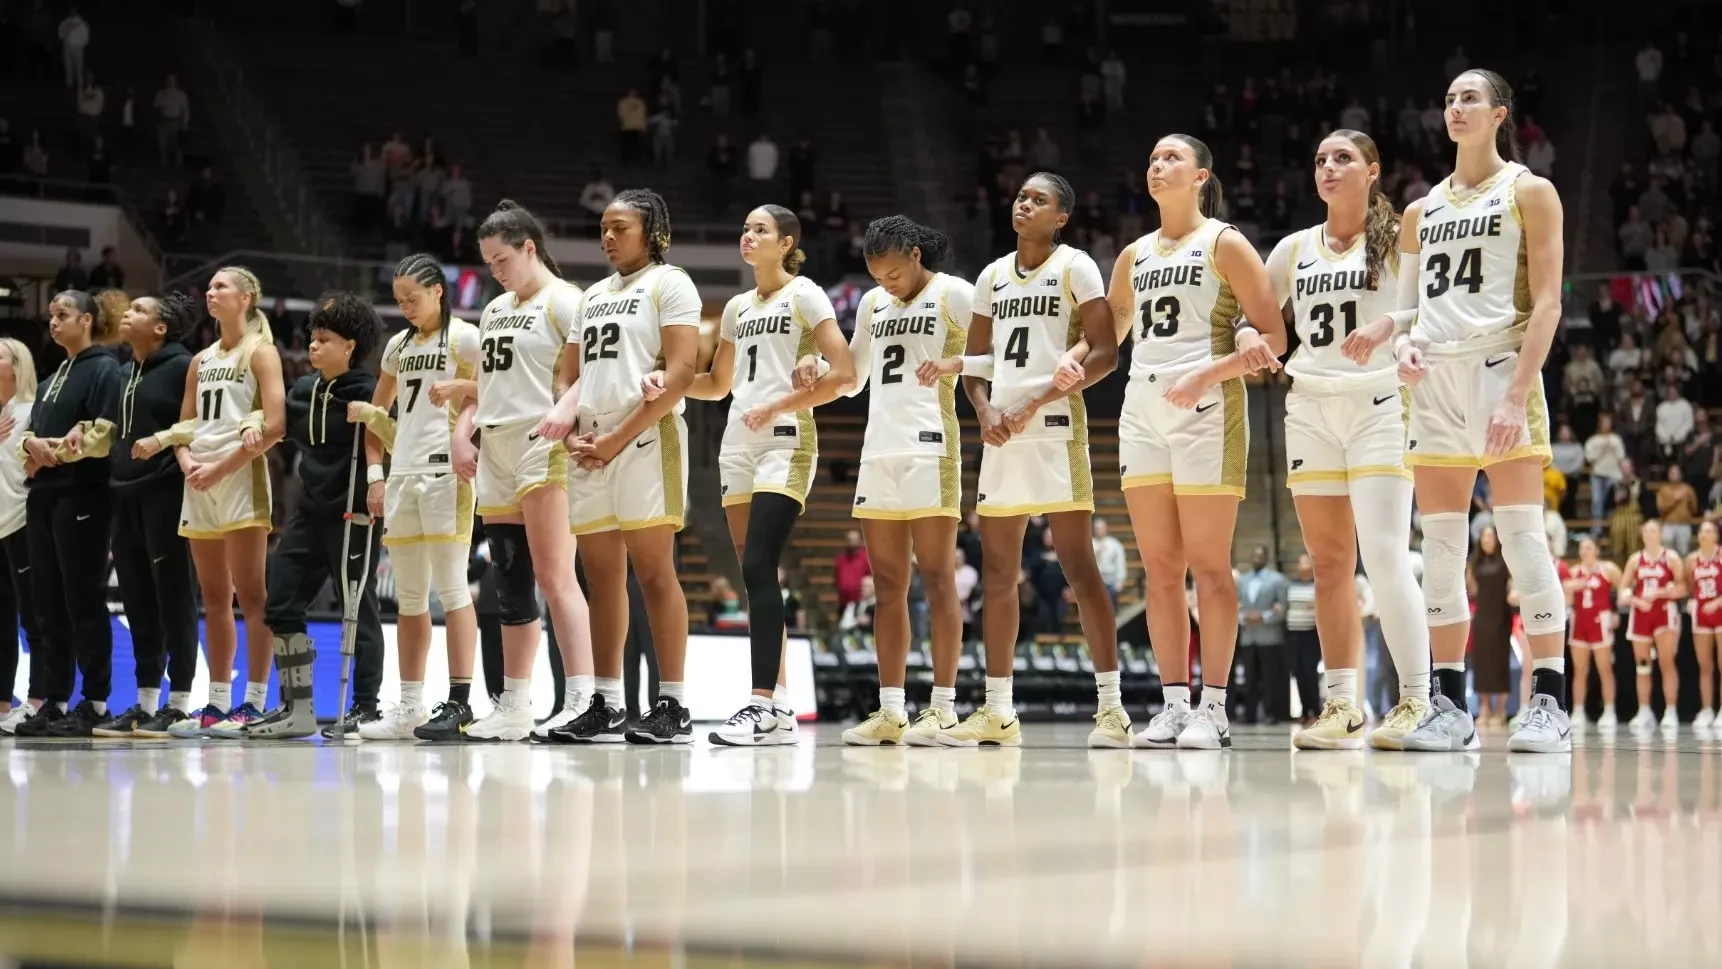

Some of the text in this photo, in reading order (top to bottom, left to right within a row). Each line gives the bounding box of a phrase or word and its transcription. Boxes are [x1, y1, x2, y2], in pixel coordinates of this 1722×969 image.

[1420, 214, 1502, 248] PURDUE
[1133, 265, 1204, 293] PURDUE
[1296, 270, 1378, 300] PURDU
[1425, 247, 1484, 299] 34
[485, 315, 536, 331] PURDUE
[584, 299, 640, 320] PURDUE
[992, 296, 1060, 321] PURDUE
[1140, 296, 1181, 339] 13
[1310, 300, 1357, 347] 31
[583, 322, 620, 364] 22
[735, 315, 792, 340] PURDUE
[870, 316, 937, 339] PURDUE
[397, 354, 447, 374] URDUE
[481, 336, 515, 374] 35
[747, 345, 758, 382] 1
[1004, 326, 1030, 368] 4
[881, 344, 906, 385] 2
[201, 388, 224, 422] 11
[406, 378, 422, 414] 7
